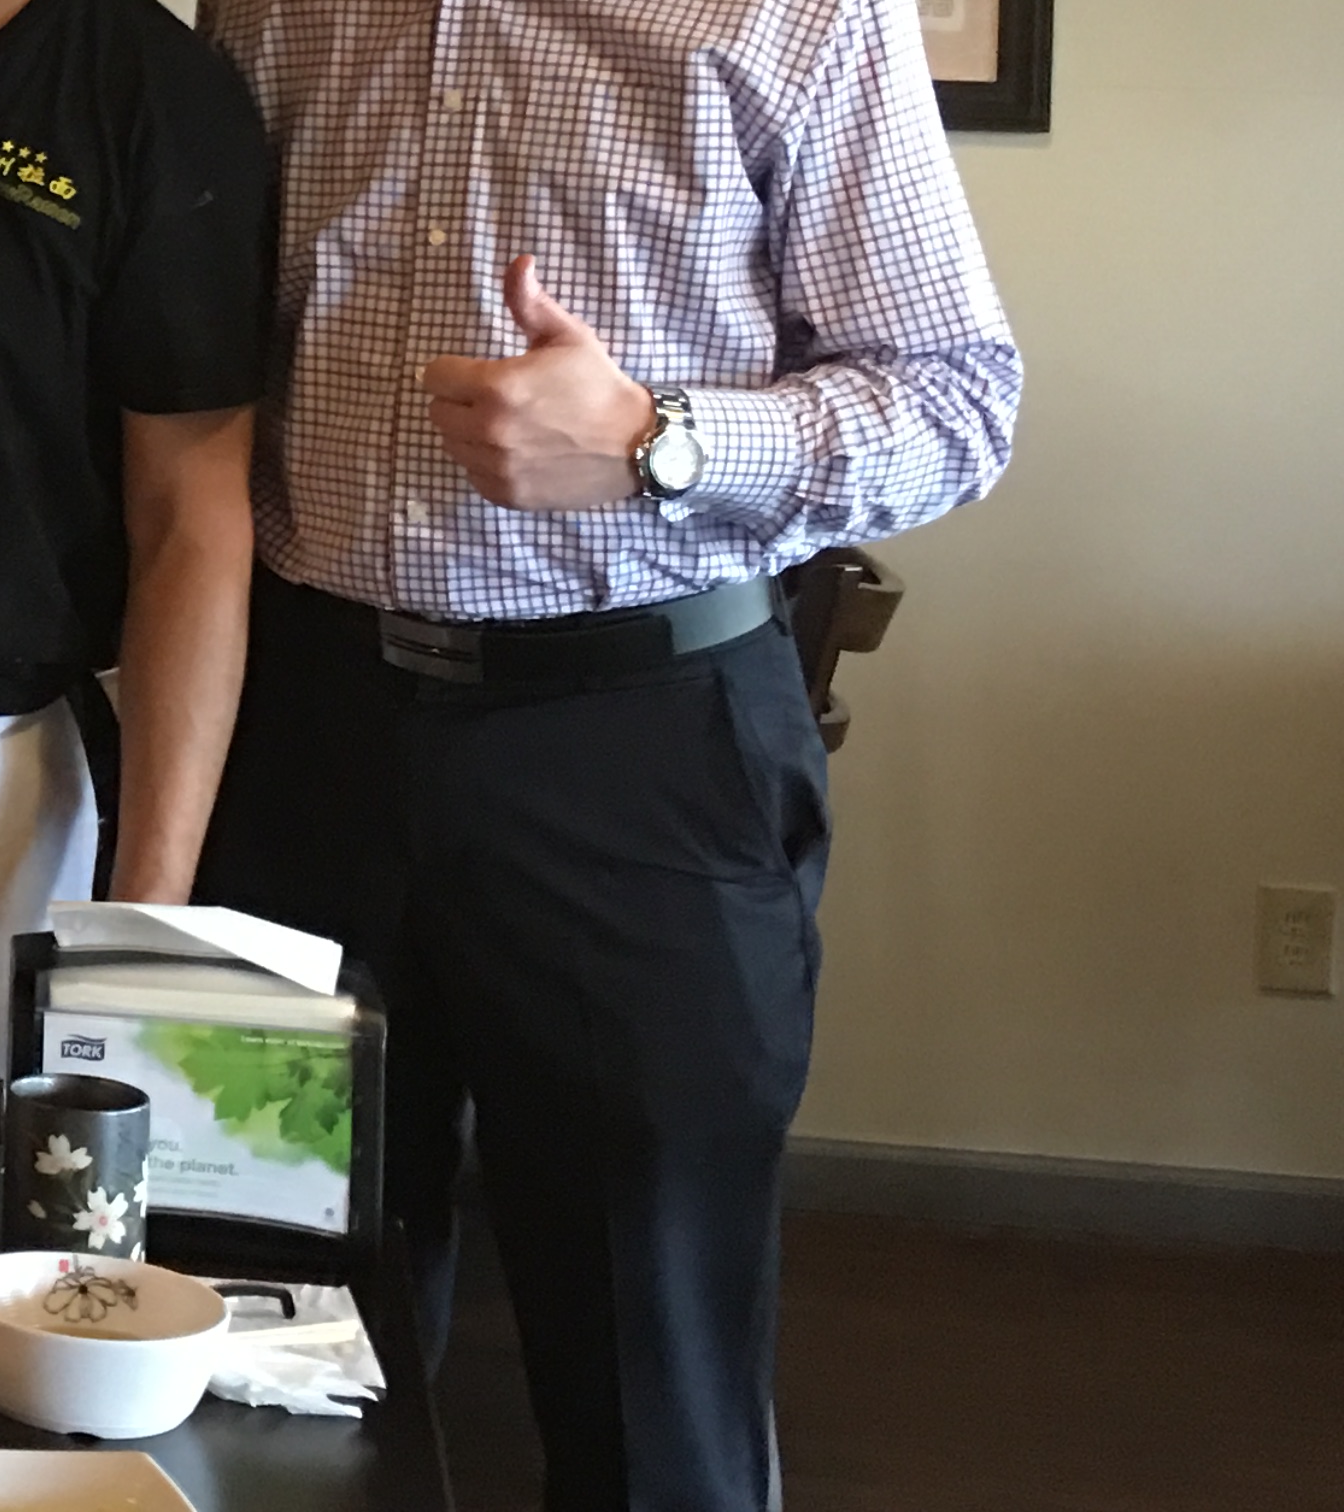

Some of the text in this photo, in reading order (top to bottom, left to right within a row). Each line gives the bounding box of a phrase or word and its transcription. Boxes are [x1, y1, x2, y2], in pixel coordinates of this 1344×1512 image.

[62, 1042, 103, 1059] TORK
[148, 1155, 239, 1176] the planet.
